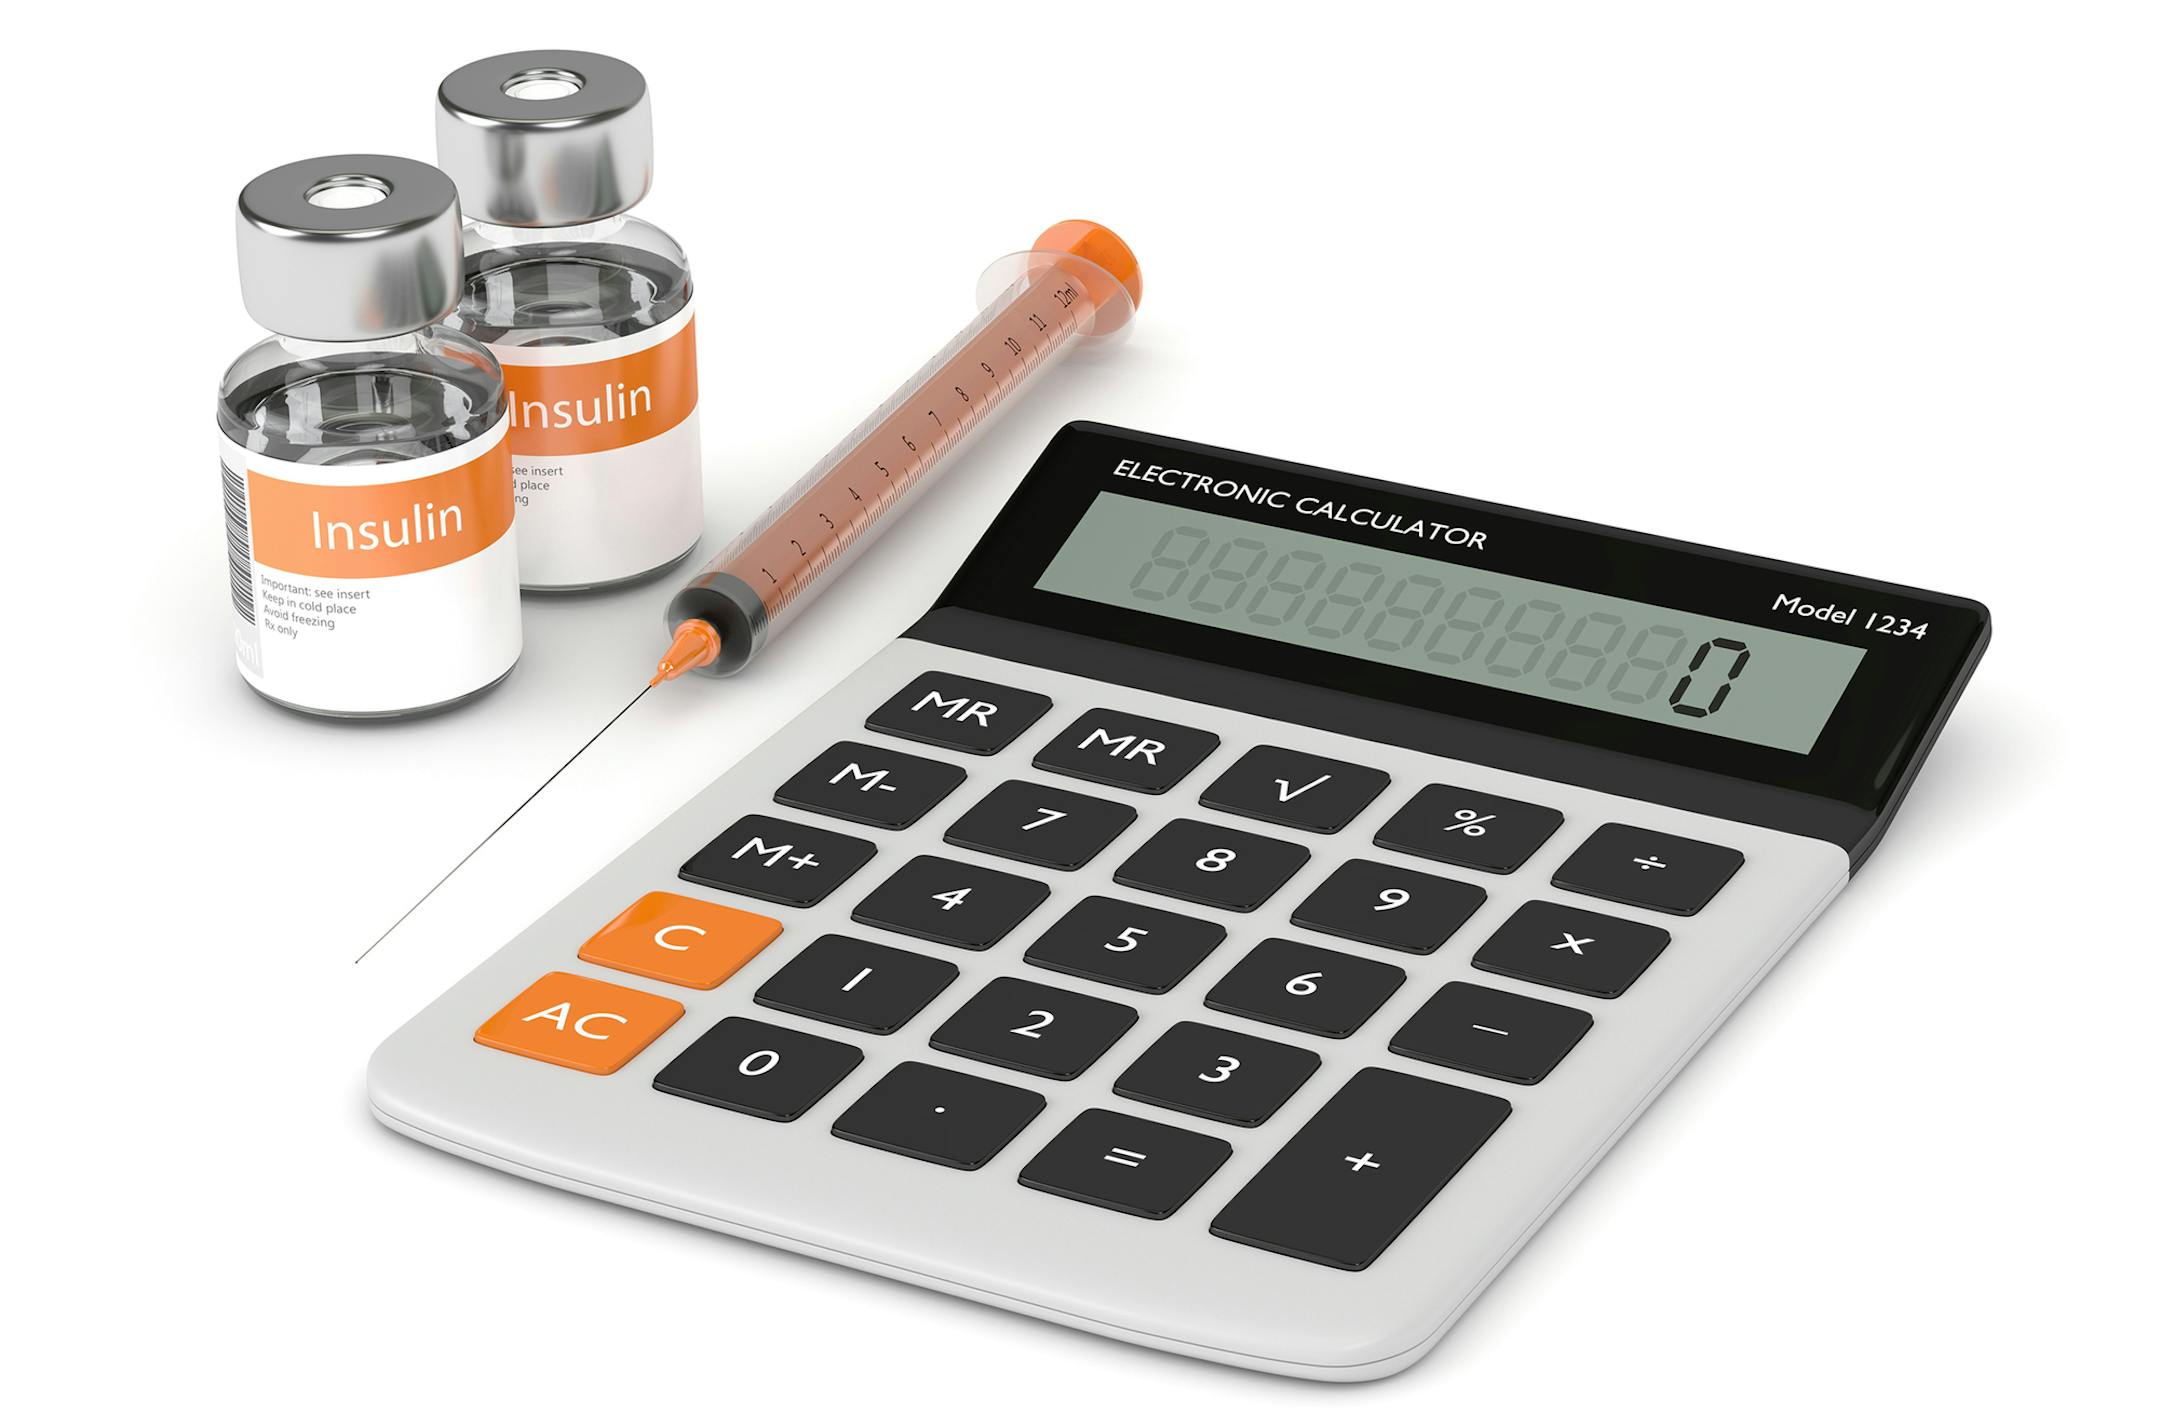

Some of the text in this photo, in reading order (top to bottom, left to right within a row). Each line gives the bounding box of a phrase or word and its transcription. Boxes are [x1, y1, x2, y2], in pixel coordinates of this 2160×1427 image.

[508, 382, 652, 430] Insulin
[762, 568, 777, 584] 1
[790, 539, 807, 556] 2
[819, 513, 834, 529] 3
[848, 486, 863, 501] 4
[874, 461, 890, 478] 5
[902, 435, 917, 452] 6
[928, 410, 942, 427] 7
[955, 386, 970, 402] 8
[981, 362, 995, 378] 9
[1004, 337, 1022, 357] 10
[1029, 313, 1047, 332] 11
[531, 465, 564, 477] insert
[520, 479, 550, 492] place
[1112, 458, 1489, 552] ELECTRONIC CALCULATOR
[311, 502, 463, 551] Insulin
[260, 573, 371, 600] Important: see insert
[261, 588, 357, 616] Keep in cold place
[263, 604, 336, 631] Avoid freezing
[264, 617, 299, 640] Rx only
[1770, 592, 1930, 641] Model 1234
[910, 690, 998, 728] MR
[1077, 728, 1166, 766] MR
[828, 762, 897, 792] M-
[1021, 807, 1068, 831] 7
[1443, 809, 1497, 837] %
[731, 836, 820, 872] M+
[1195, 848, 1237, 872] 8
[931, 887, 972, 911] 4
[1373, 888, 1411, 911] 9
[654, 925, 706, 951] C
[1103, 926, 1149, 952] 5
[1285, 972, 1323, 996] 6
[522, 1002, 628, 1040] AC
[1009, 1010, 1055, 1039] 2
[738, 1050, 780, 1076] 0
[1198, 1055, 1241, 1083] 3
